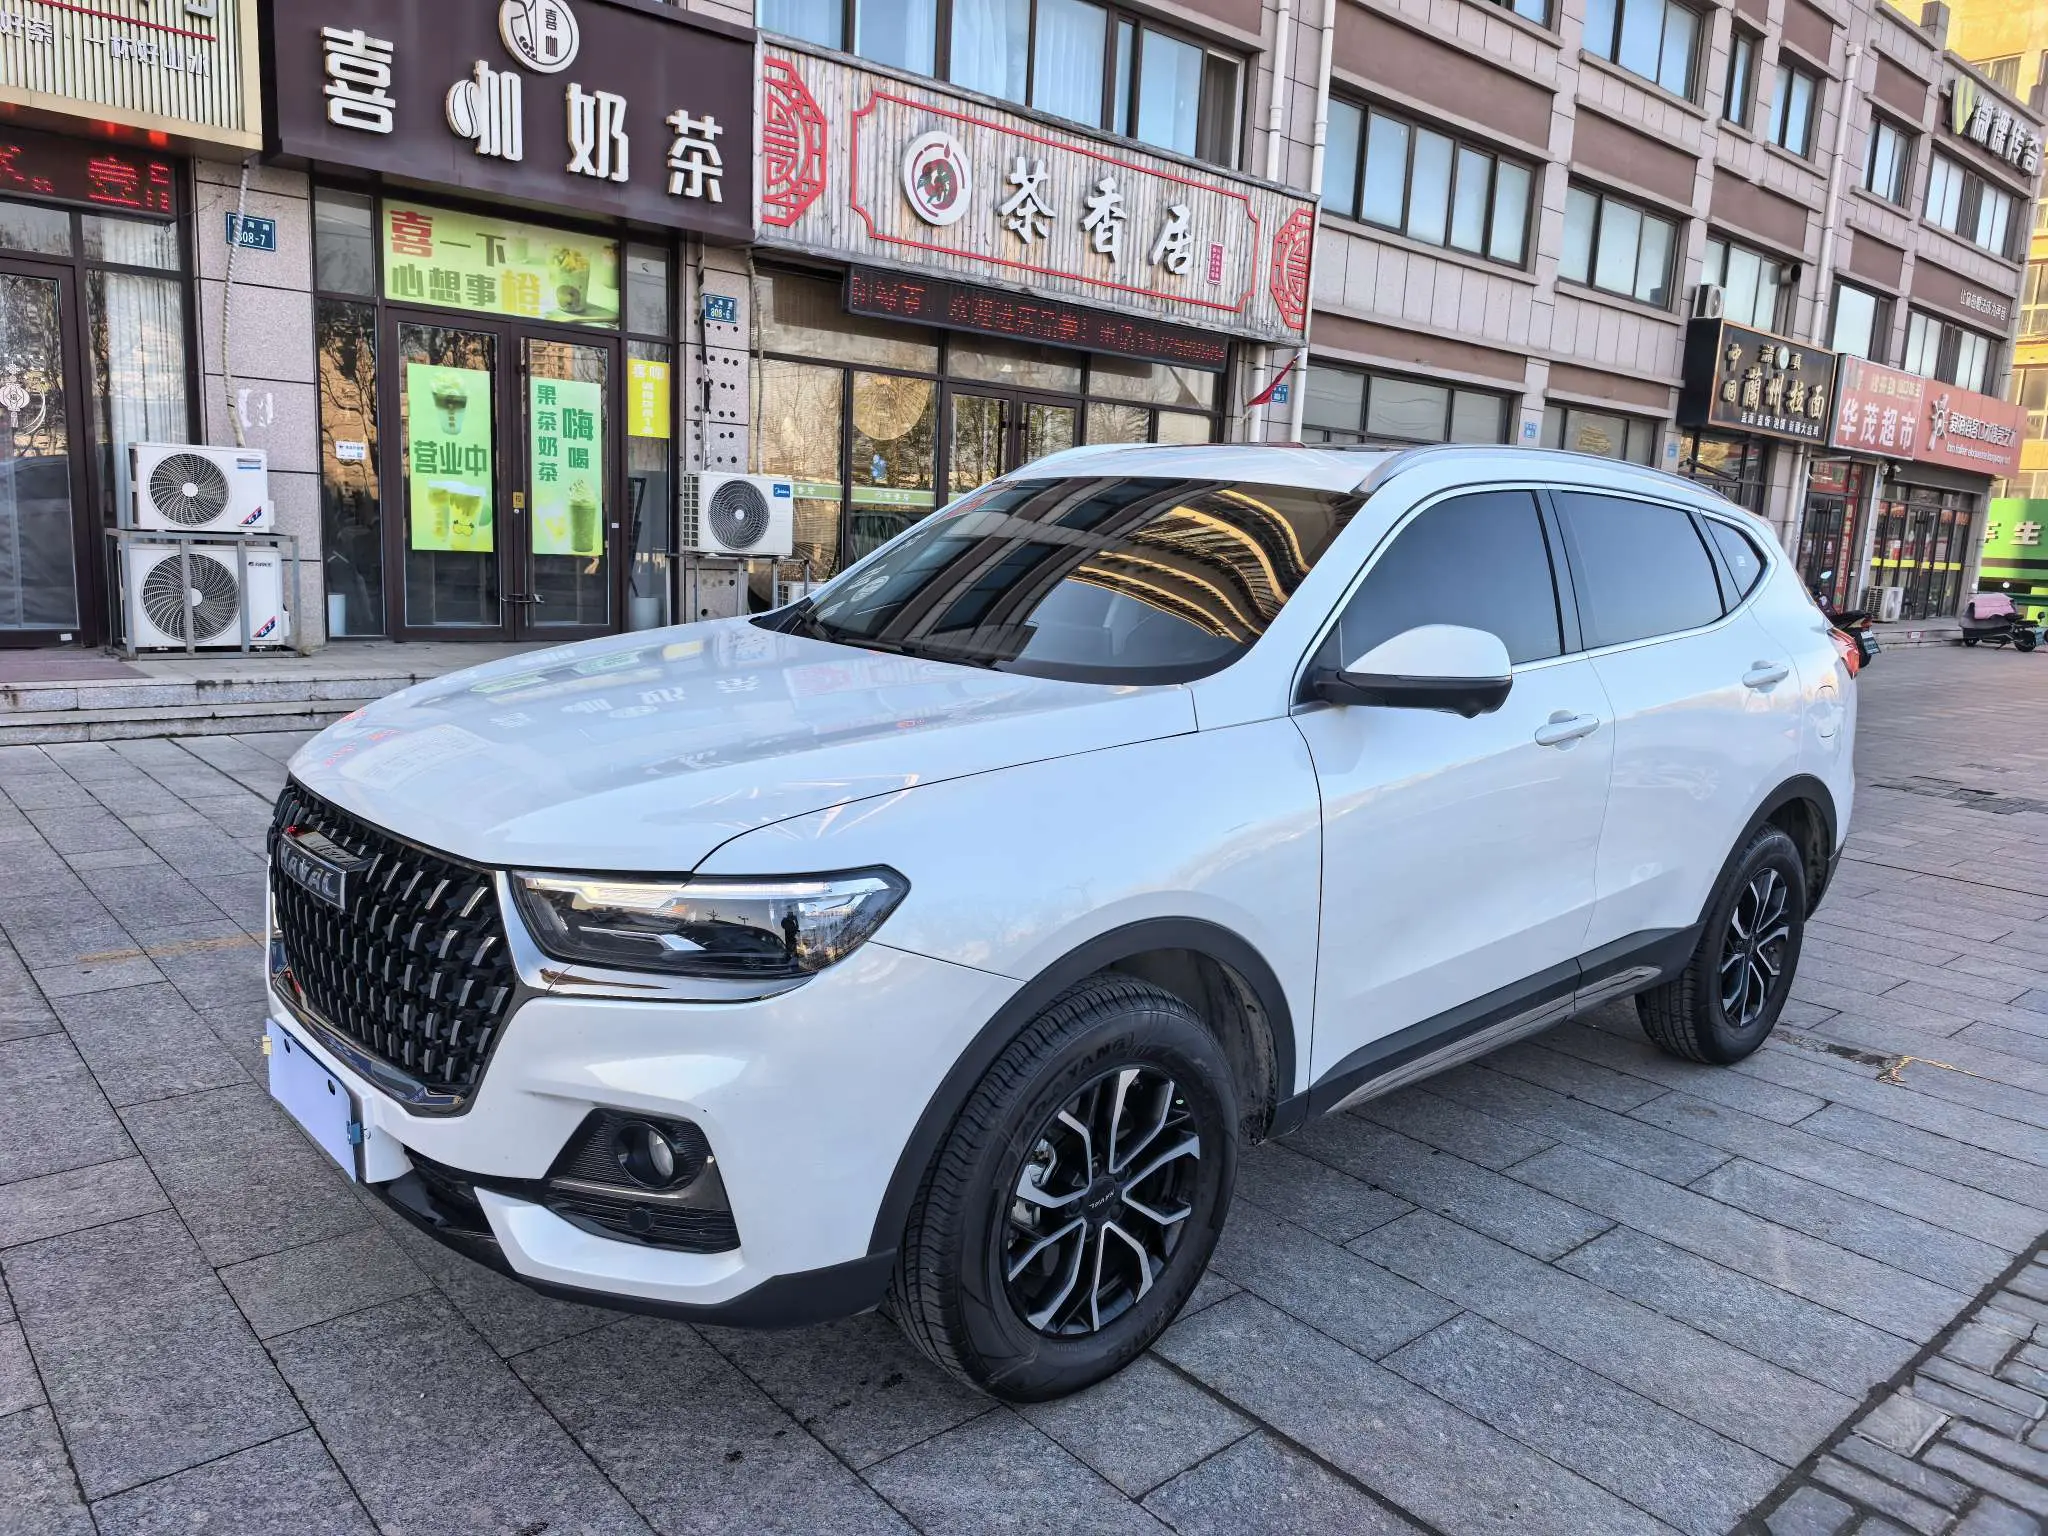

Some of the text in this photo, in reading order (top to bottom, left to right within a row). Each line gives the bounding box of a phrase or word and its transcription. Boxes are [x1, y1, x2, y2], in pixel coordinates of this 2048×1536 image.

[320, 26, 724, 203] 喜咖奶茶
[389, 209, 508, 269] 喜一下
[1000, 155, 1192, 276] 茶香居
[391, 262, 541, 317] 心想事橙
[537, 385, 558, 482] 果茶奶茶
[562, 407, 594, 470] 嗨喝
[1840, 397, 1917, 452] 华茂超市
[413, 440, 488, 477] 营业中
